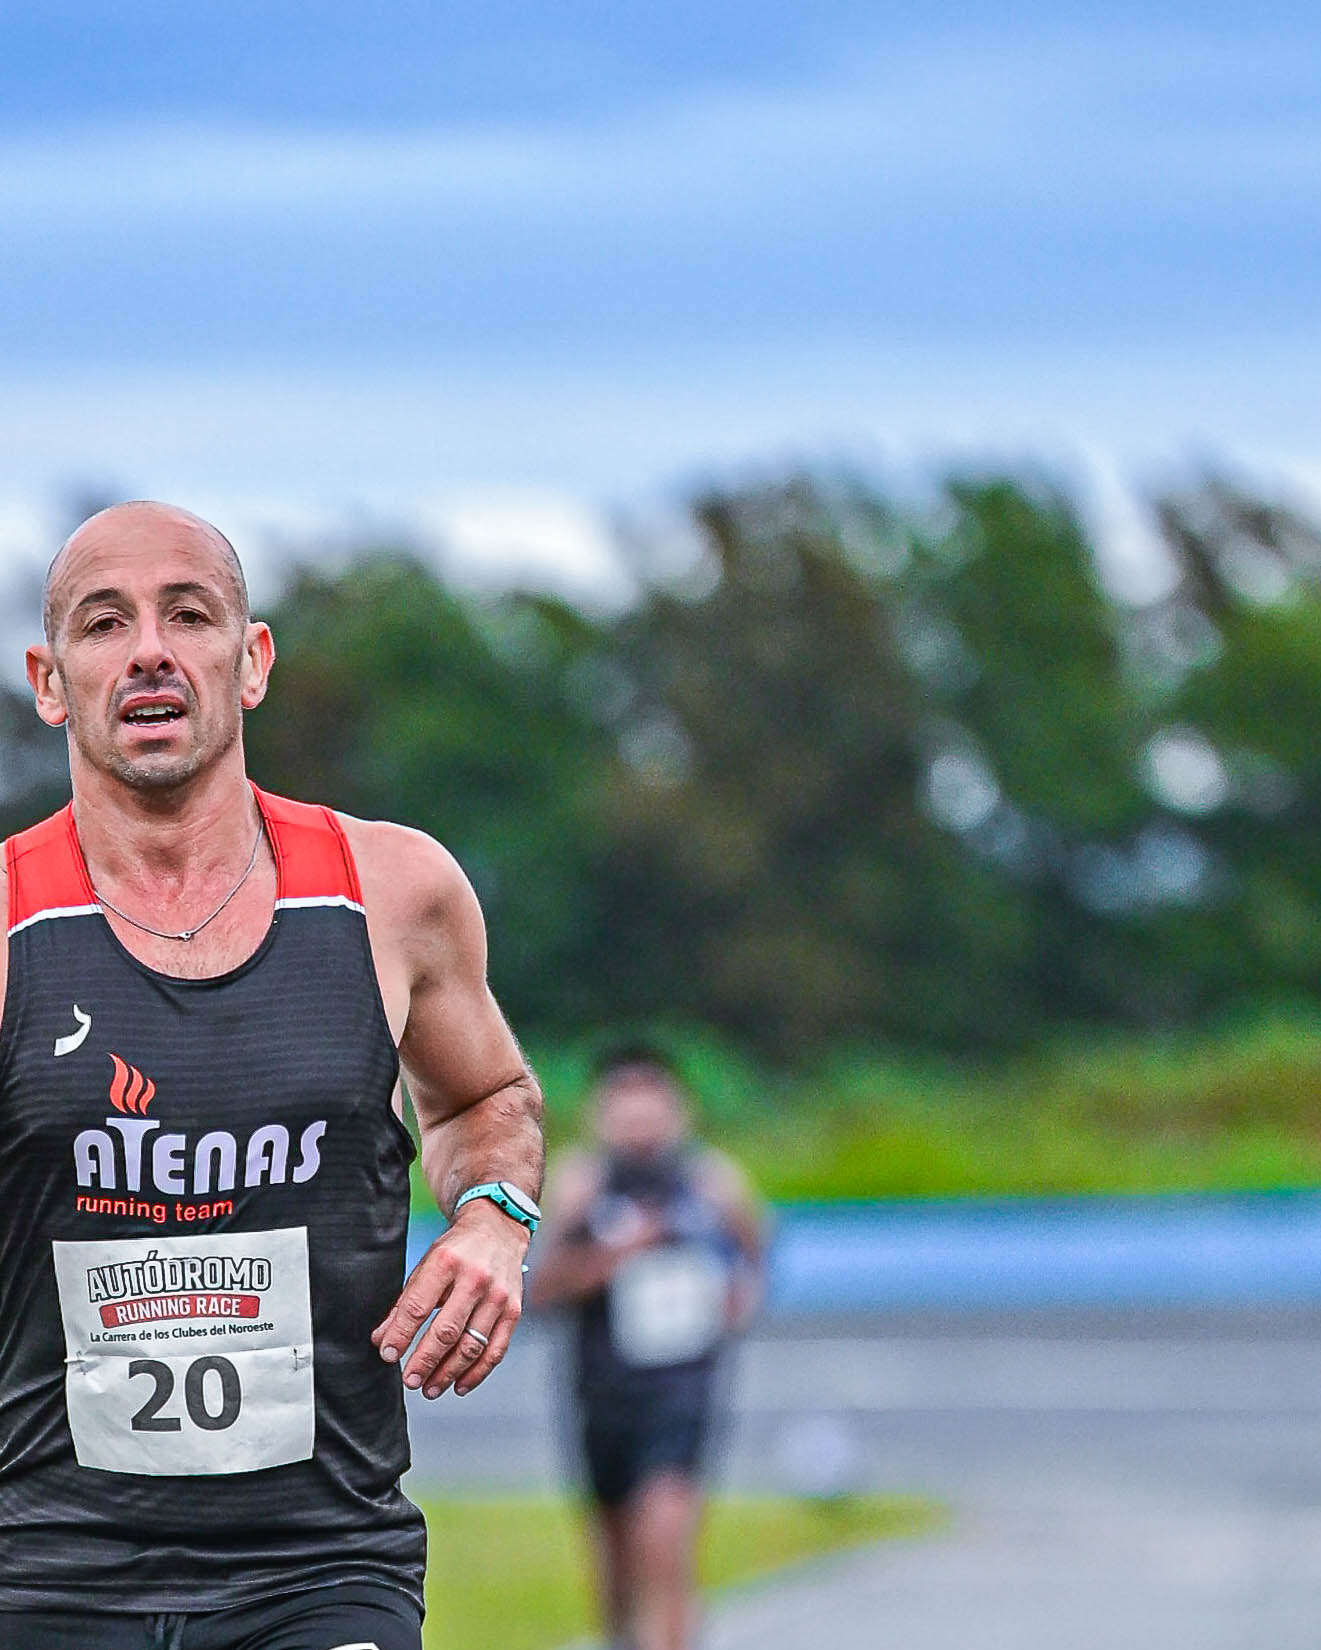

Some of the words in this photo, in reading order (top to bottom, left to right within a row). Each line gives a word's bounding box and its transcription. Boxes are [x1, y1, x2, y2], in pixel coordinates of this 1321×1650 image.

[73, 1117, 327, 1195] ATENAS
[75, 1195, 167, 1224] running
[175, 1198, 234, 1222] team
[86, 1250, 273, 1304] AUTÓDROMO
[115, 1298, 192, 1324] RUNNING
[195, 1297, 242, 1317] RACE
[89, 1332, 101, 1343] La
[102, 1331, 137, 1342] Carrera
[138, 1329, 153, 1341] de
[154, 1328, 170, 1340] los
[171, 1326, 208, 1339] Clubes
[209, 1324, 226, 1336] del
[228, 1321, 275, 1335] Noroeste
[128, 1355, 242, 1432] 20
